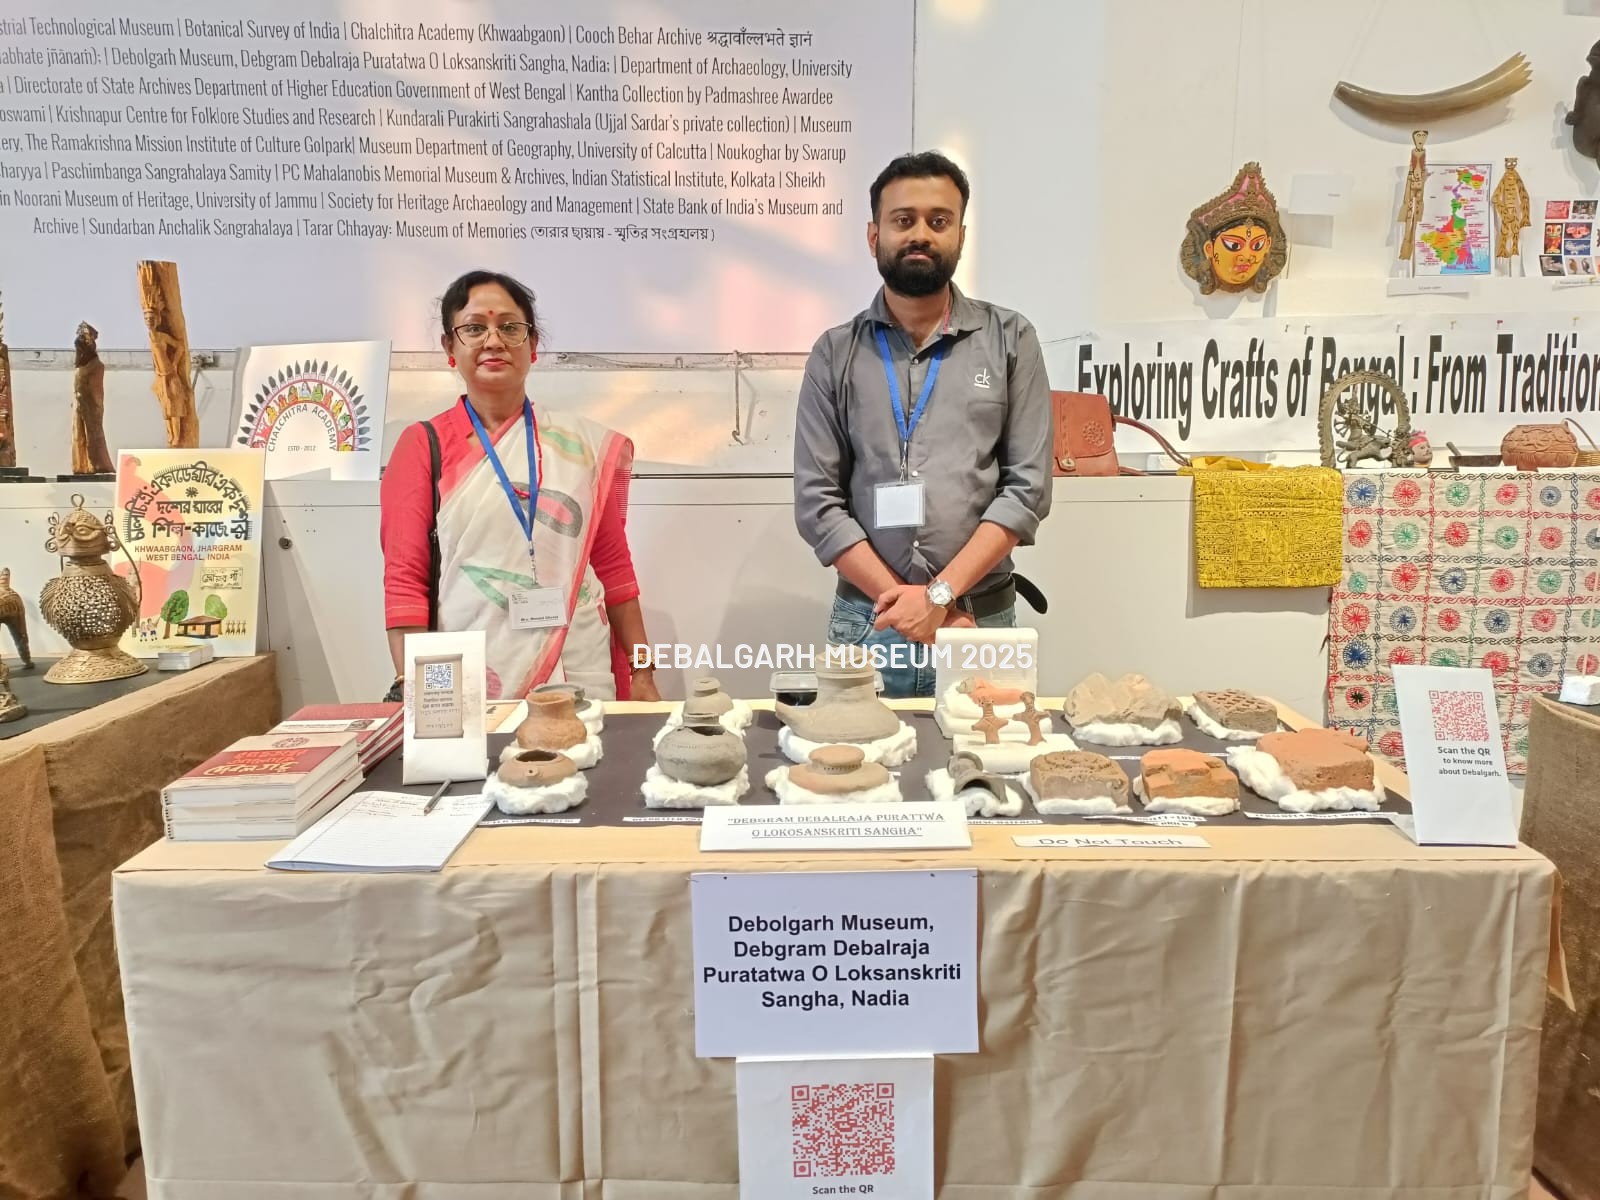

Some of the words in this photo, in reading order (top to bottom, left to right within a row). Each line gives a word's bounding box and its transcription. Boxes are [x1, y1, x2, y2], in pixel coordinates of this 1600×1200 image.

[29, 17, 116, 38] Technological
[119, 18, 175, 36] Museum
[184, 19, 244, 38] Botanical
[246, 20, 290, 40] Survey
[309, 21, 340, 39] India
[351, 22, 414, 40] Chalchitra
[418, 23, 474, 43] Academy
[478, 24, 566, 45] (Khwaabgaon)
[576, 25, 615, 44] Cooch
[618, 26, 653, 44] Behar
[657, 27, 702, 45] Archive
[111, 48, 177, 69] Debolgarh
[179, 48, 238, 68] Museum,
[240, 50, 297, 71] Debgram
[300, 50, 360, 71] Debalraja
[363, 52, 426, 69] Puratatwa
[442, 53, 516, 71] Loksanskriti
[519, 53, 568, 74] Sangha,
[621, 56, 693, 76] Department
[711, 57, 789, 79] Archaeology,
[792, 59, 853, 78] University
[14, 76, 83, 94] Directorate
[101, 77, 135, 94] State
[139, 77, 192, 95] Archives
[194, 78, 268, 98] Department
[287, 79, 328, 100] Higher
[331, 79, 393, 98] Education
[396, 80, 471, 98] Government
[489, 82, 520, 100] West
[524, 82, 566, 103] Bengal
[576, 84, 619, 102] Kantha
[622, 85, 684, 103] Collection
[705, 86, 779, 104] Padmashree
[782, 87, 833, 105] Awardee
[55, 105, 122, 126] Krishnapur
[126, 105, 168, 123] Centre
[191, 106, 240, 124] Folklore
[242, 107, 290, 125] Studies
[318, 108, 376, 126] Research
[386, 109, 444, 127] Kundarali
[448, 110, 500, 128] Purakirti
[503, 111, 591, 131] Sangrahashala
[595, 113, 627, 133] (Ujjal
[683, 115, 723, 135] private
[727, 115, 790, 133] collection)
[800, 116, 852, 133] Museum
[51, 133, 132, 151] Ramakrishna
[135, 134, 183, 152] Mission
[186, 136, 237, 152] Institute
[255, 136, 301, 153] Culture
[359, 137, 412, 154] Museum
[415, 138, 488, 157] Department
[507, 139, 574, 160] Geography,
[577, 141, 638, 161] University
[656, 142, 707, 160] Calcutta
[717, 143, 781, 163] Noukoghar
[802, 144, 846, 163] Swarup
[51, 162, 142, 183] Paschimbanga
[144, 163, 227, 183] Sangrahalaya
[229, 163, 272, 183] Samity
[303, 164, 381, 182] Mahalanobis
[384, 165, 441, 182] Memorial
[445, 166, 497, 184] Museum
[514, 168, 568, 186] Archives,
[572, 169, 608, 186] Indian
[611, 169, 671, 187] Statistical
[674, 171, 727, 188] Institute,
[731, 171, 775, 188] Kolkata
[785, 171, 825, 188] Sheikh
[14, 190, 62, 206] Noorani
[64, 190, 119, 207] Museum
[137, 191, 193, 211] Heritage,
[196, 192, 256, 210] University
[275, 192, 317, 208] Jammu
[327, 192, 374, 211] Society
[397, 193, 449, 213] Heritage
[452, 194, 527, 215] Archaeology
[556, 196, 633, 216] Management
[643, 197, 674, 214] State
[678, 198, 708, 214] Bank
[768, 199, 818, 215] Museum
[33, 217, 79, 234] Archive
[89, 218, 155, 235] Sundarban
[158, 218, 211, 235] Anchalik
[213, 219, 293, 238] Sangrahalaya
[302, 218, 333, 236] Tarar
[337, 219, 392, 239] Chhayay:
[396, 220, 448, 238] Museum
[467, 222, 527, 239] Memories
[973, 368, 991, 386] ck
[1078, 341, 1193, 441] Exploring
[1202, 337, 1278, 419] Crafts
[1287, 336, 1314, 418] of
[1320, 335, 1405, 435] Bengal
[1425, 335, 1487, 414] From
[1496, 333, 1600, 414] Tradition
[268, 403, 308, 452] CHALCHITRA
[311, 405, 337, 451] ACADEMY
[134, 545, 195, 553] KHWAABGAON,
[146, 553, 168, 561] WEST
[207, 553, 230, 561] INDIA
[1437, 746, 1459, 754] Scan
[1460, 746, 1476, 755] the
[1477, 747, 1491, 756] QR
[797, 814, 873, 823] DEBALRAJA
[876, 812, 945, 822] PURATTWA
[763, 828, 862, 837] LOKOSANSKRITI
[728, 915, 834, 935] Debolgarh
[841, 914, 934, 933] Museum,
[734, 941, 826, 961] Debgram
[833, 939, 930, 959] Debalraja
[703, 966, 805, 983] Puratatwa
[812, 965, 828, 982] O
[835, 963, 961, 982] Loksanskriti
[761, 990, 845, 1011] Sangha,
[851, 990, 909, 1007] Nadia
[812, 1186, 836, 1195] Scan
[839, 1185, 856, 1194] the
[859, 1184, 874, 1194] QR
